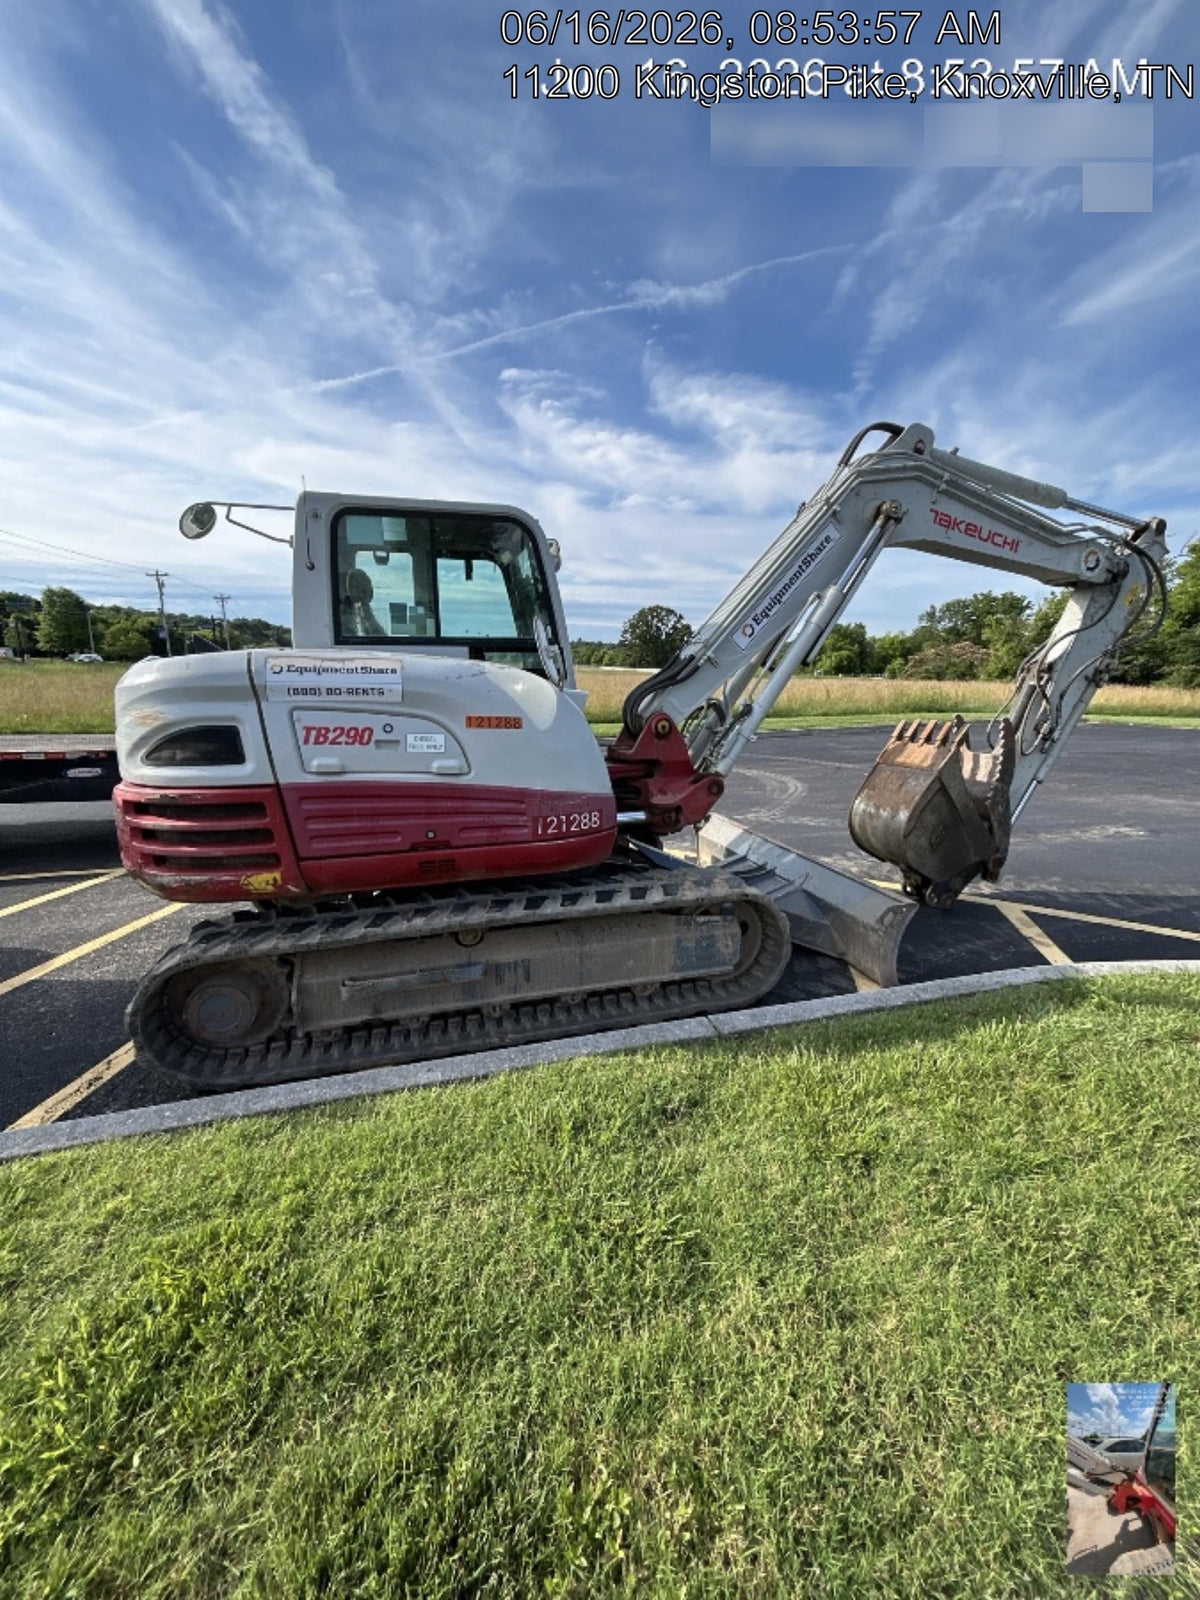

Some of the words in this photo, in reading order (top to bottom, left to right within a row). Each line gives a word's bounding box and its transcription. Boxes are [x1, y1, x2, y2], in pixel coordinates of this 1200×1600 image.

[752, 534, 833, 626] EquipmentShare
[286, 664, 398, 676] EquipmentShare
[468, 716, 521, 730] 121288
[302, 726, 374, 746] TB290
[538, 811, 600, 835] 121288
